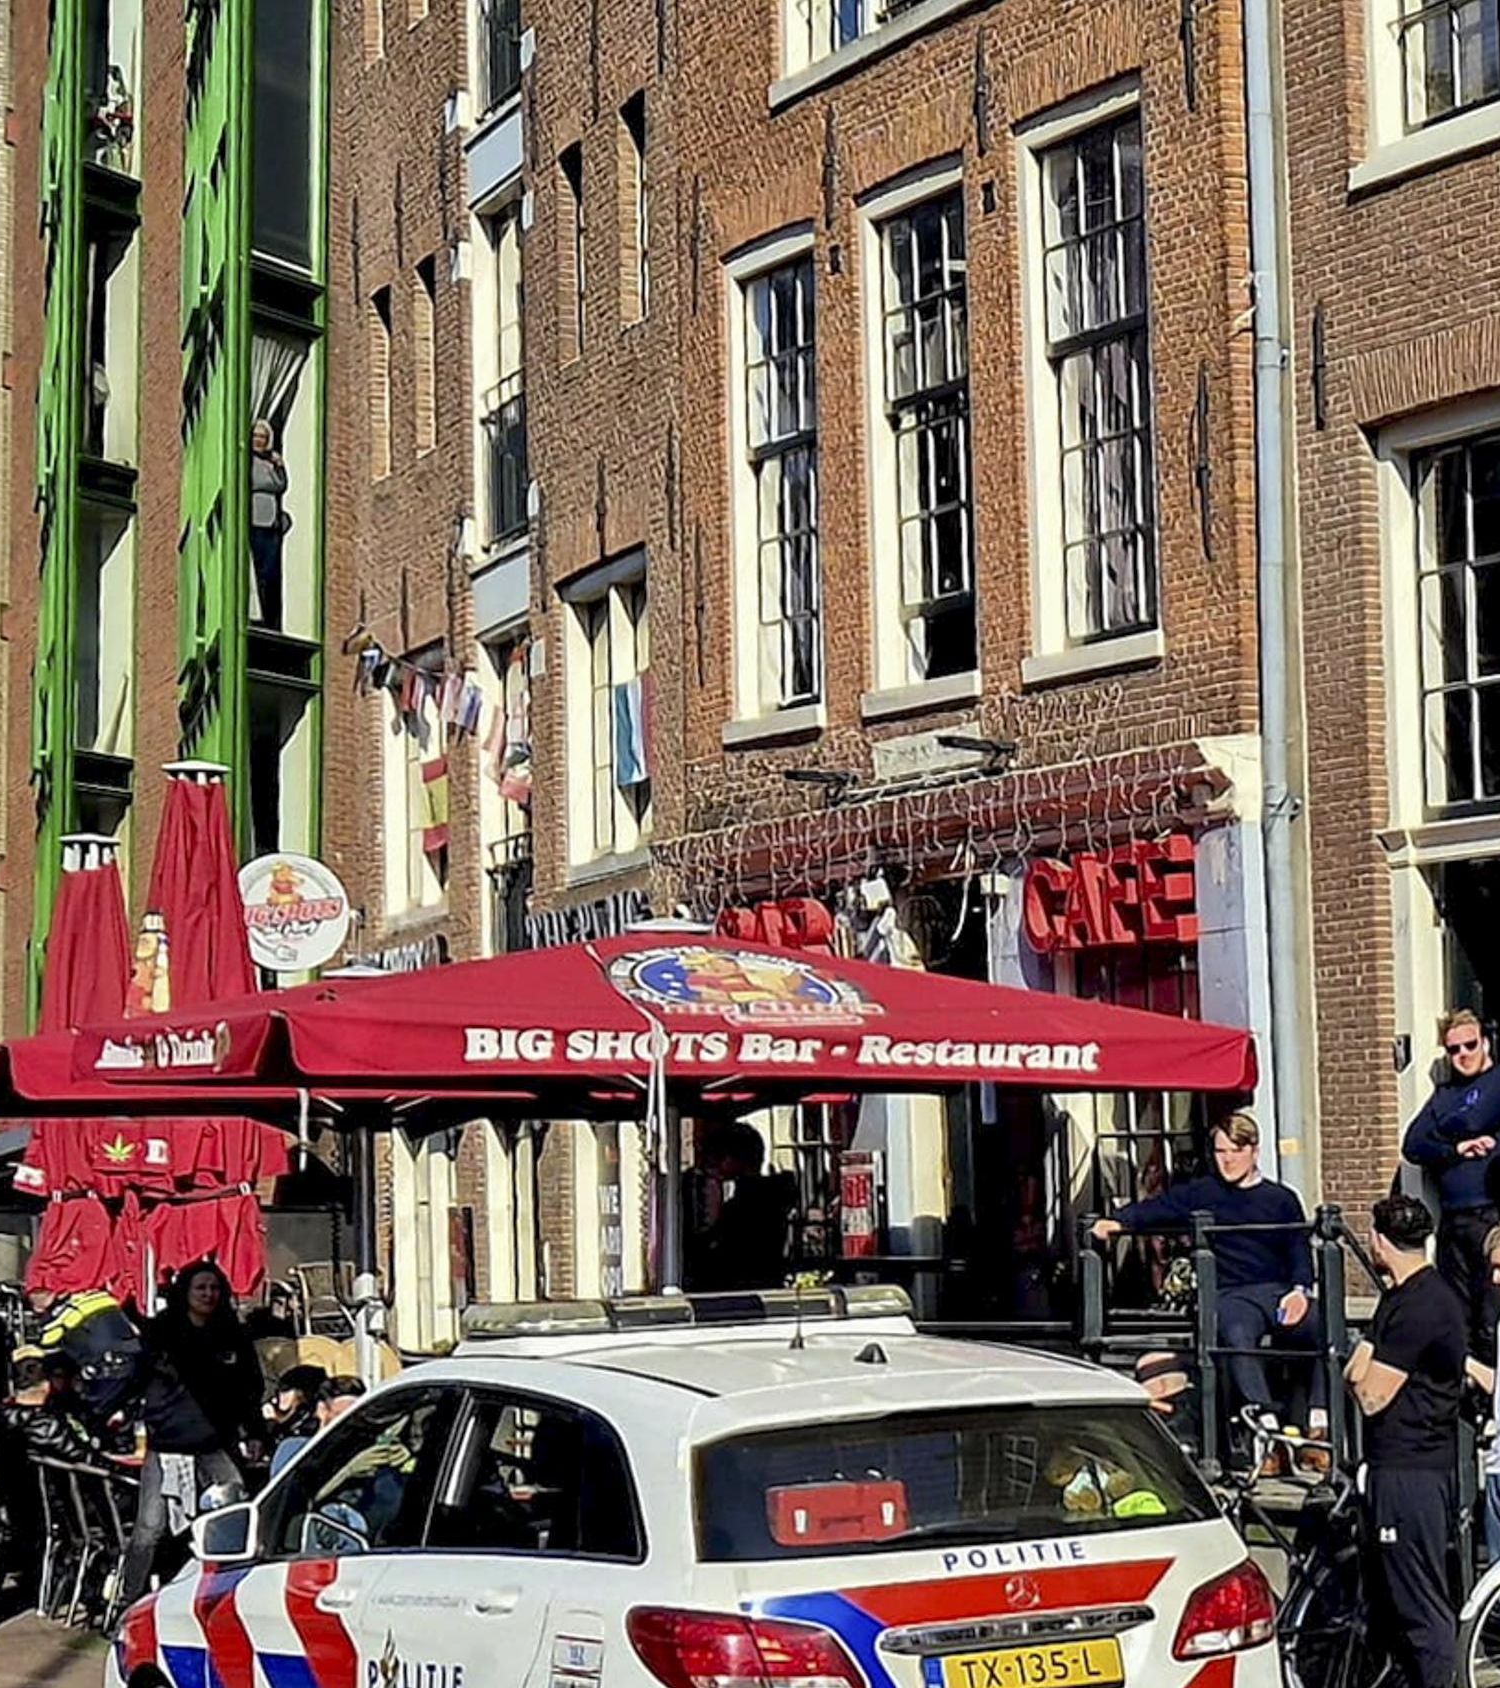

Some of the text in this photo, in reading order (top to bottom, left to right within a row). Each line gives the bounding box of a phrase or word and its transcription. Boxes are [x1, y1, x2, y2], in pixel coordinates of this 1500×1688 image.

[1024, 834, 1197, 954] CAFE
[464, 1028, 555, 1062] BIG
[566, 1029, 730, 1063] SHOTS
[737, 1032, 823, 1064] Bar
[857, 1034, 1100, 1072] Restaurant
[942, 1541, 1086, 1572] POLITIE
